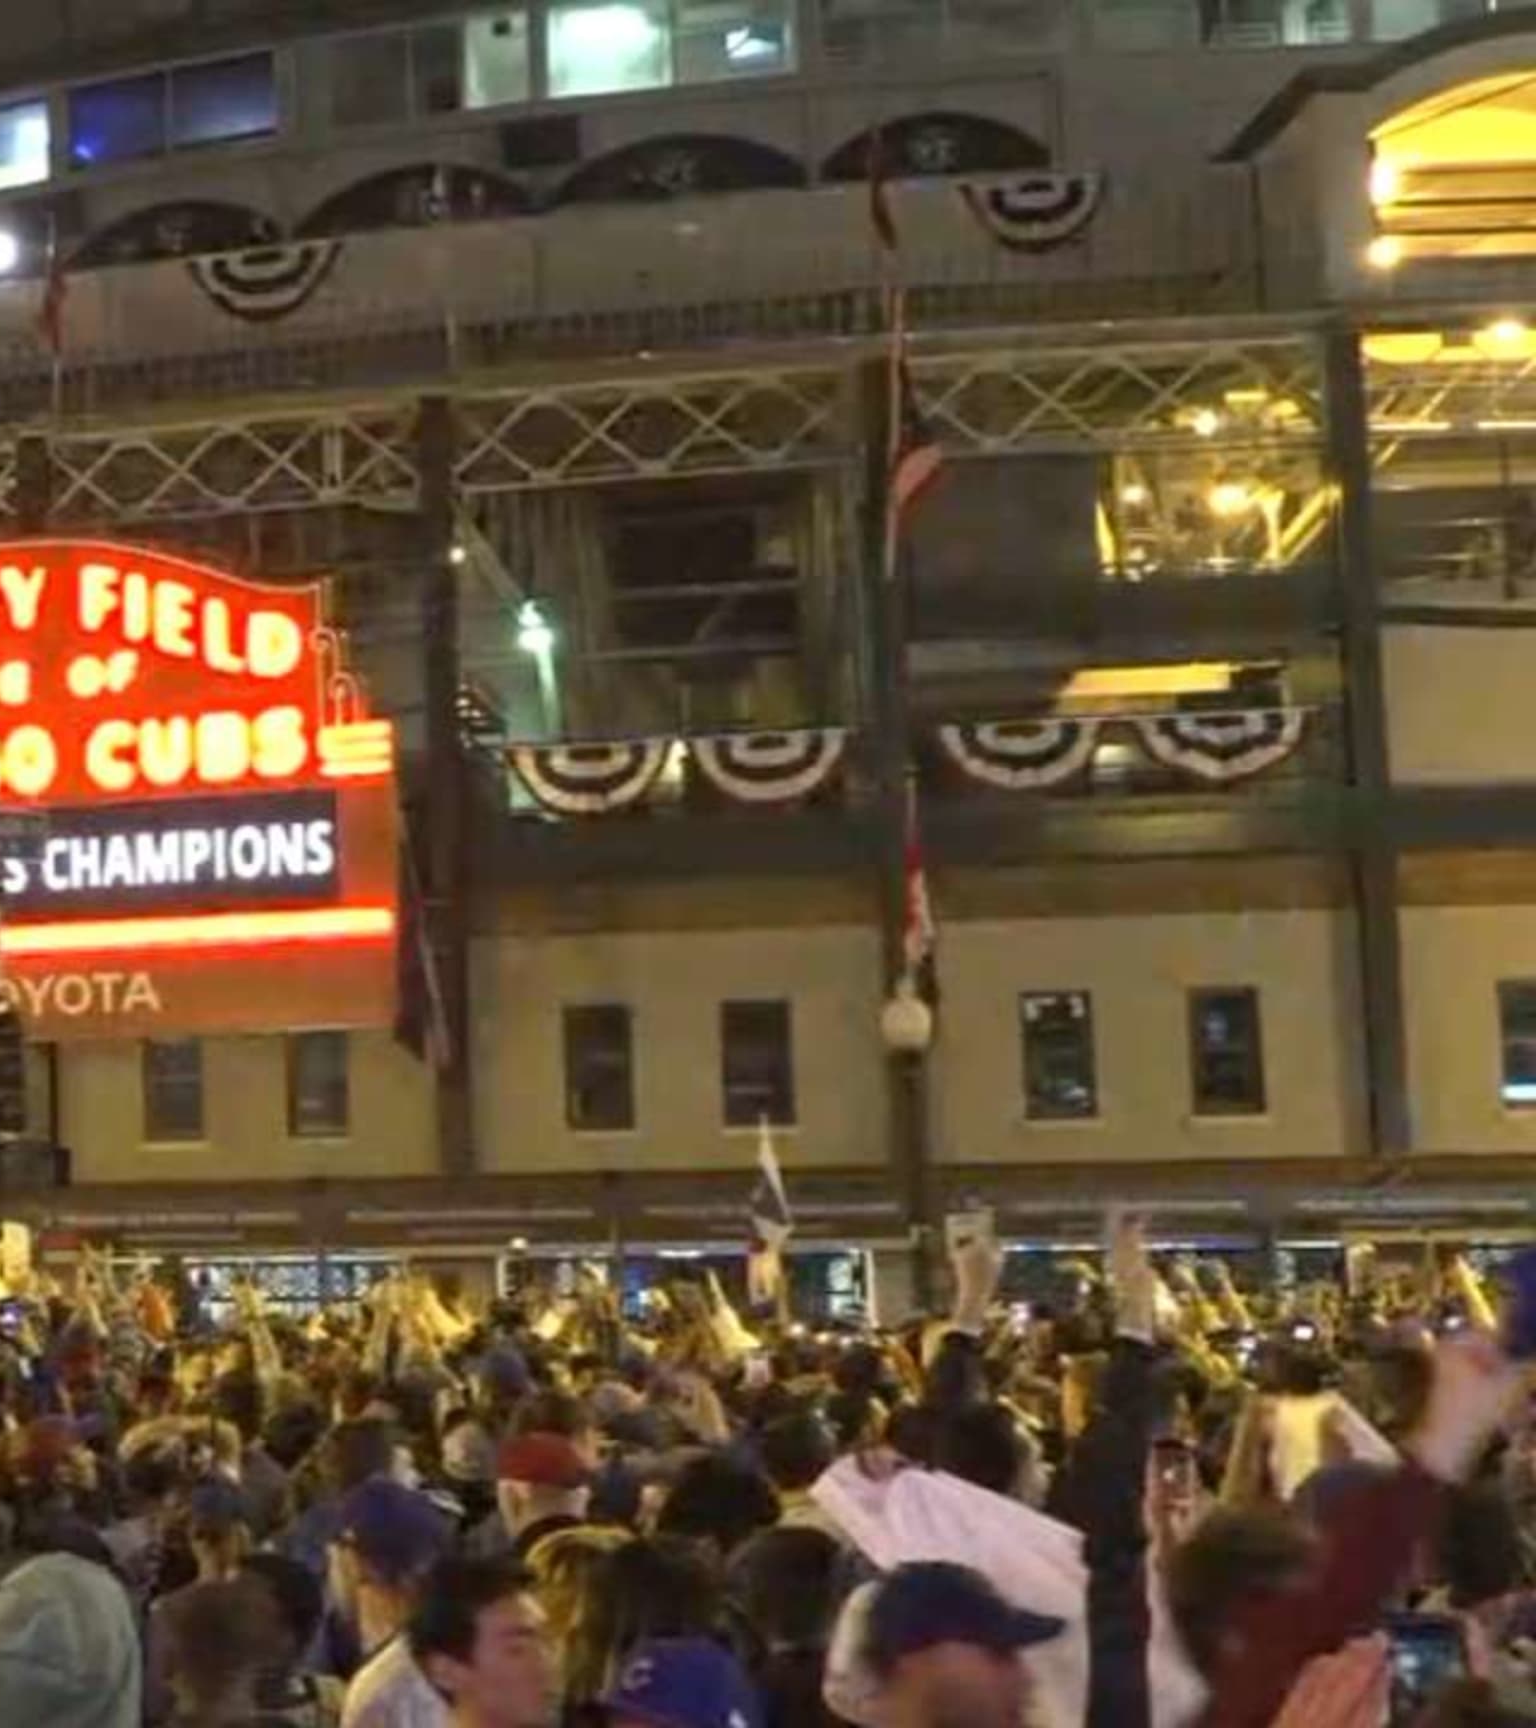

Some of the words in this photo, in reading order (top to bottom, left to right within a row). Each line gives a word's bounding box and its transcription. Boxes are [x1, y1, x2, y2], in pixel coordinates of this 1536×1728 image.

[79, 564, 302, 677] FIELD
[85, 705, 308, 790] CUBS
[41, 820, 335, 891] CHAMPIONS
